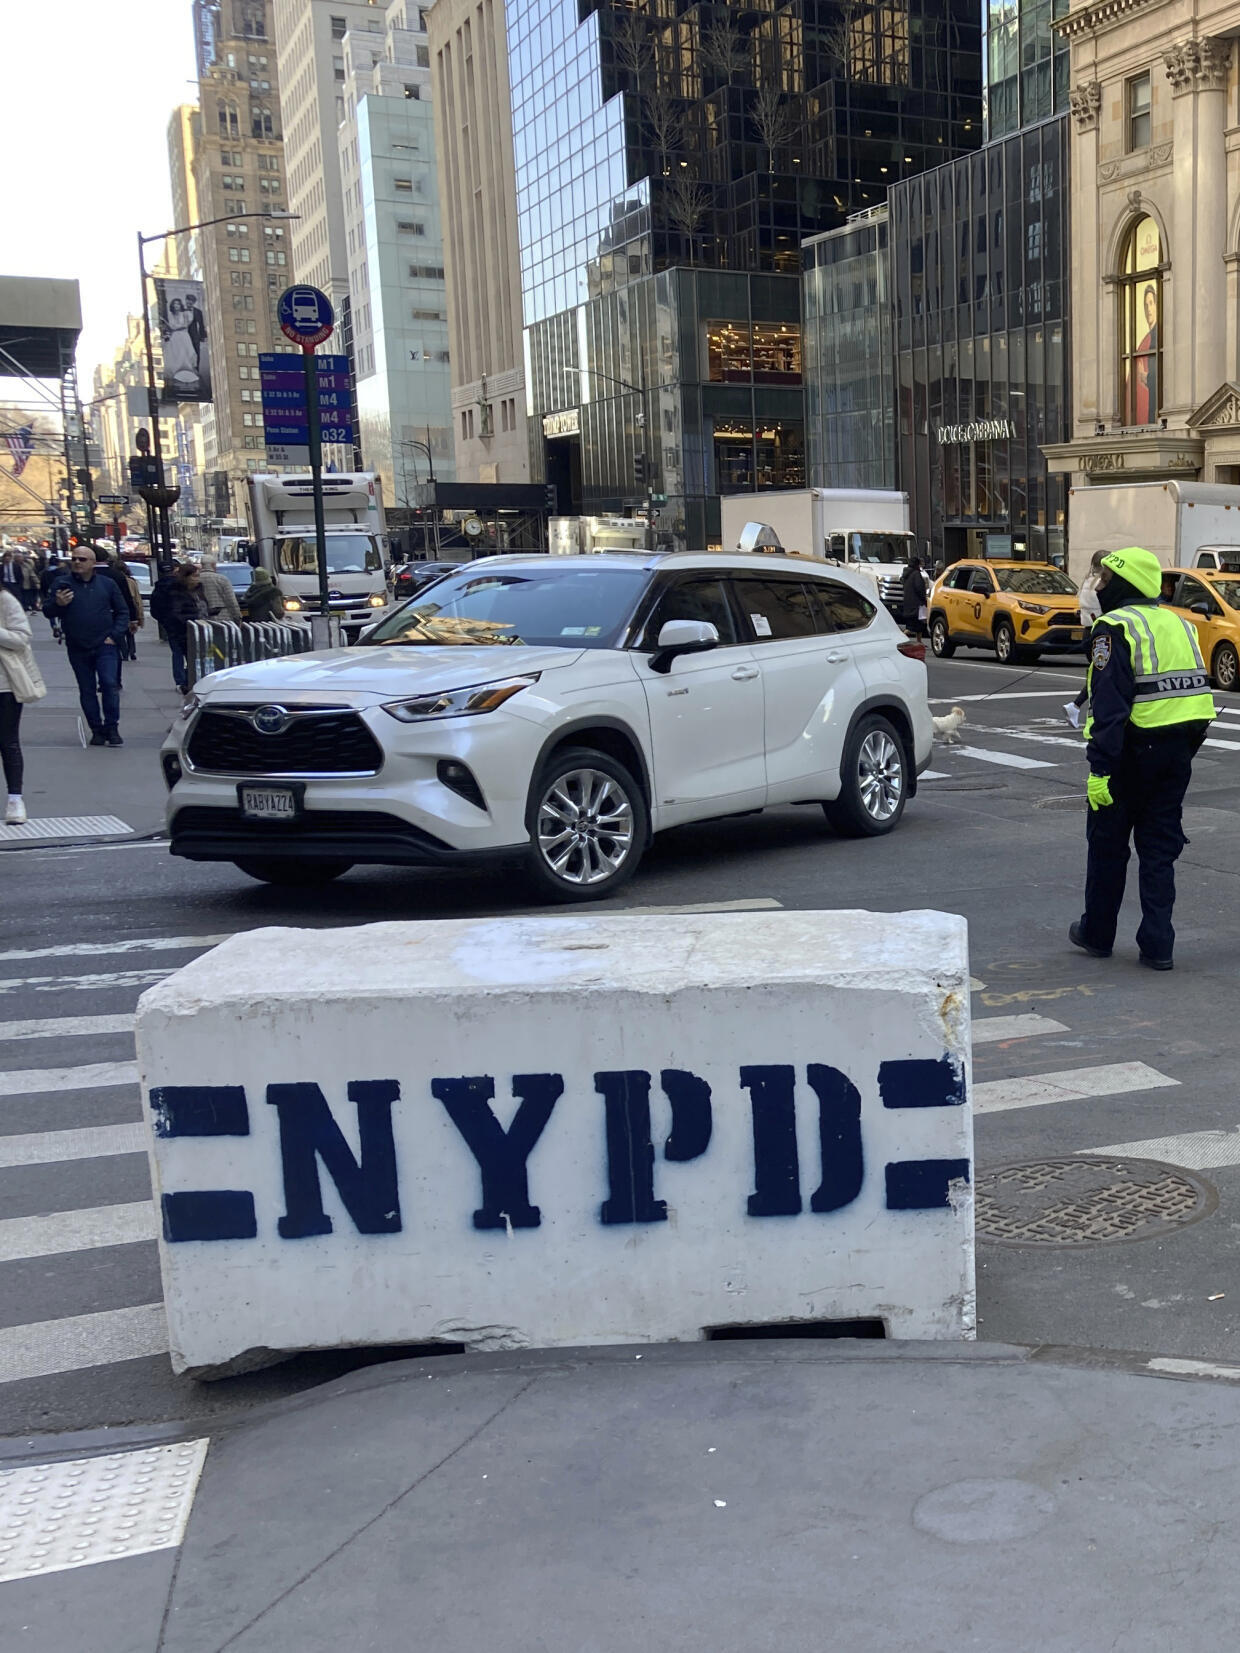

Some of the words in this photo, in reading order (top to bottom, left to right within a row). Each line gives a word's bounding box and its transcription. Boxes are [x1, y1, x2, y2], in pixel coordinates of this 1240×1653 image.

[317, 358, 334, 370] M1
[319, 375, 335, 388] M1
[320, 392, 338, 406] M4
[321, 411, 339, 423] M4
[1105, 553, 1125, 569] YPD
[1157, 675, 1206, 692] NYPD
[267, 1062, 865, 1239] NYPD
